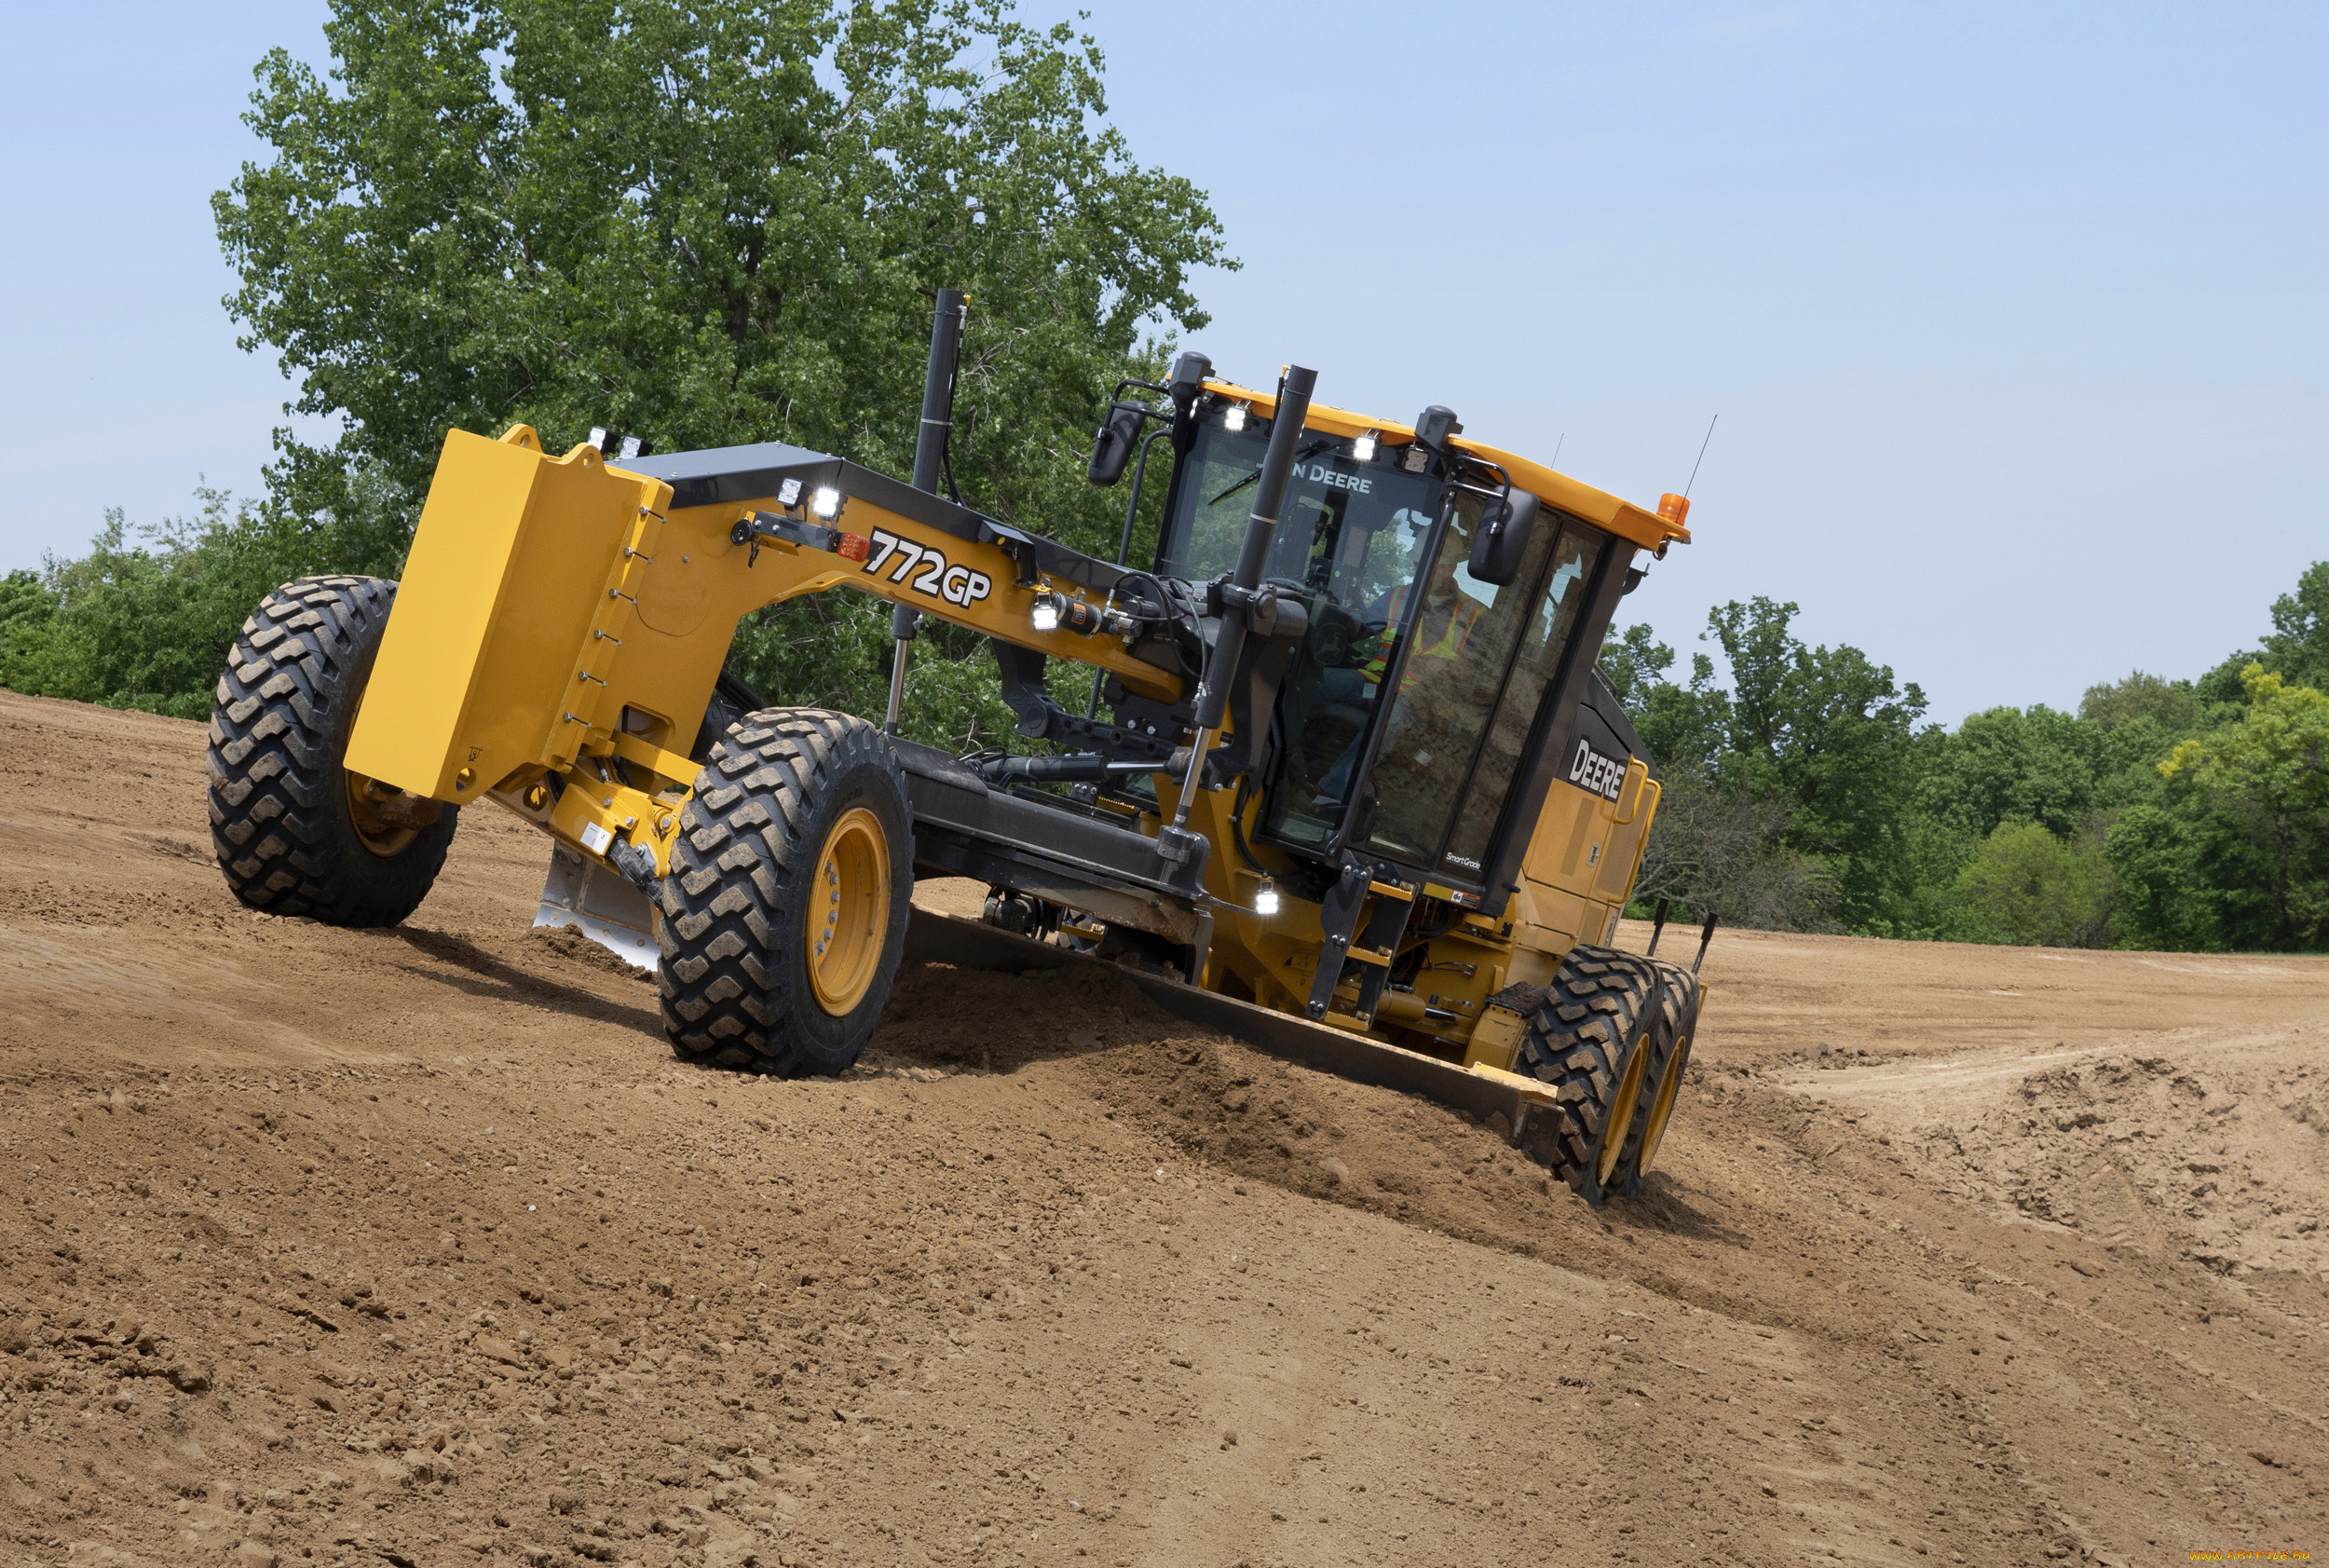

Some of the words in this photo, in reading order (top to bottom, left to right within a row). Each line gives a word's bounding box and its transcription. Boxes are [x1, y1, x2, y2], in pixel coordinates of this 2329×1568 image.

[1309, 464, 1372, 494] DEERE
[864, 528, 992, 608] 772GP
[1569, 739, 1626, 799] DEERE
